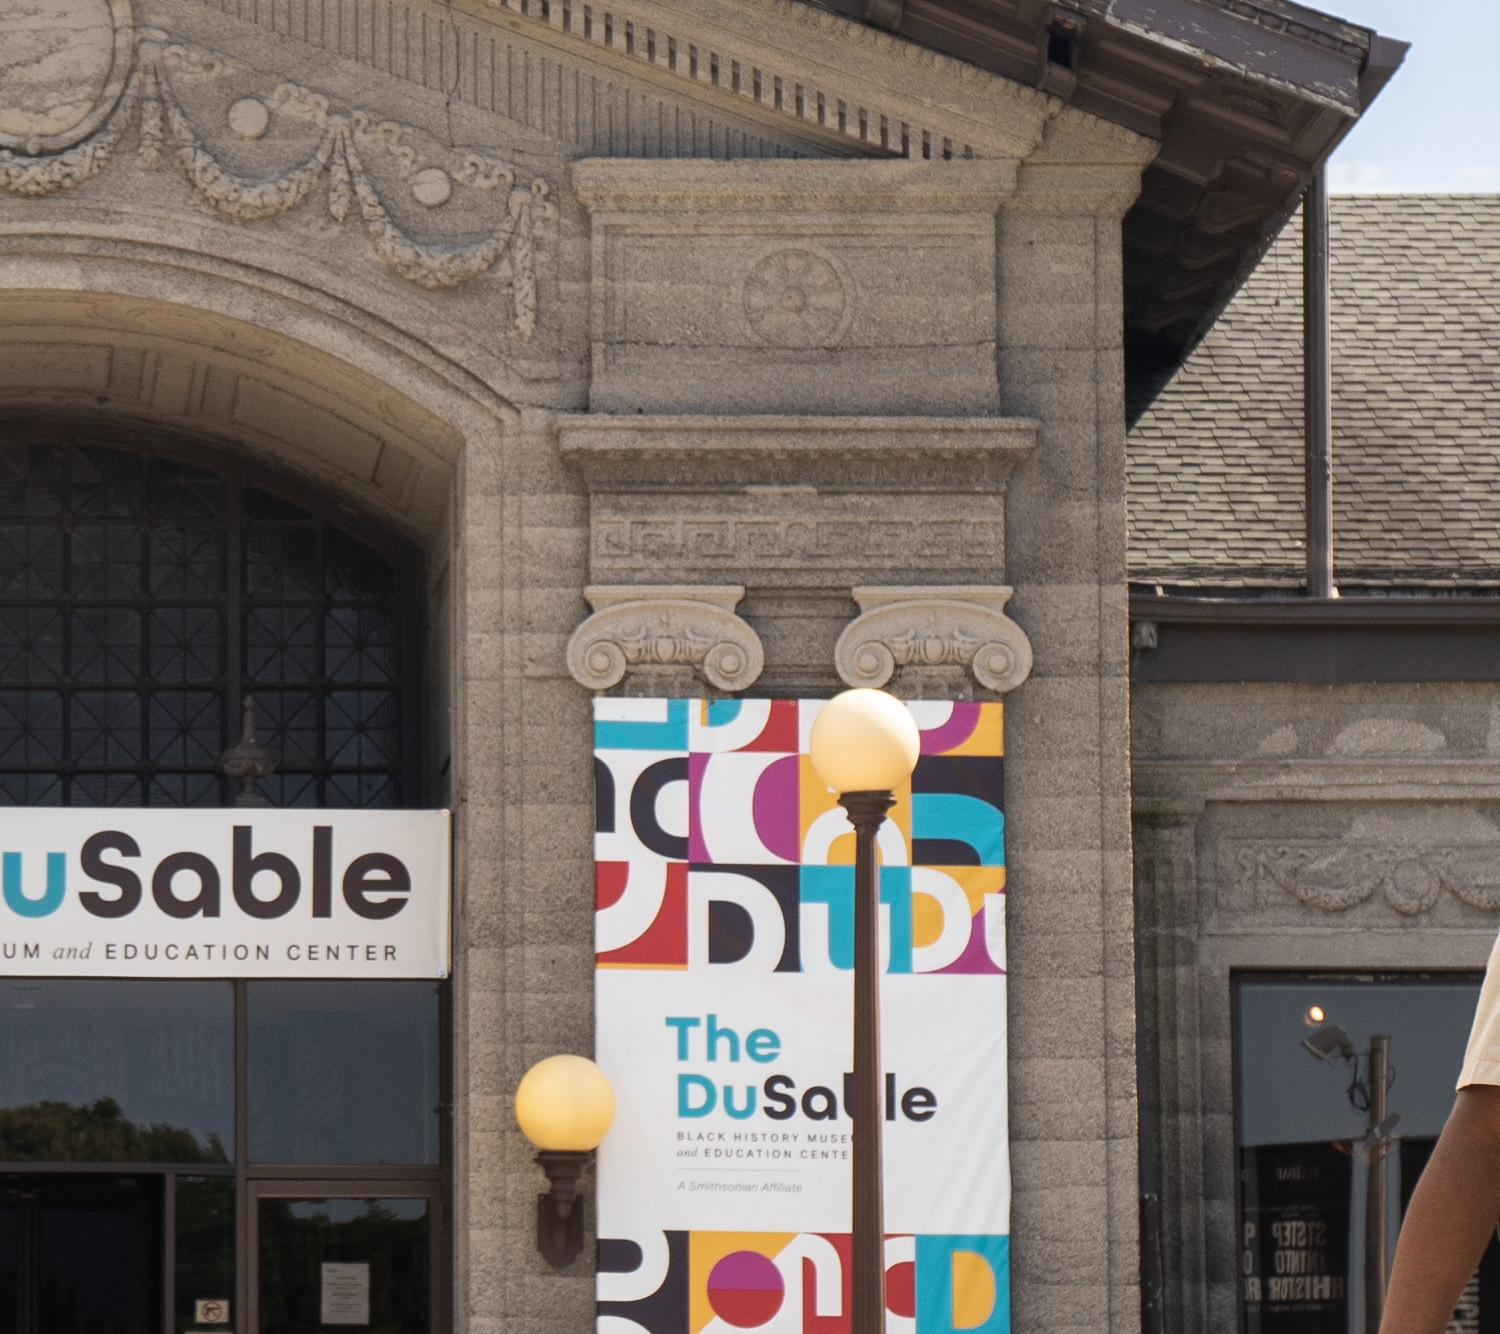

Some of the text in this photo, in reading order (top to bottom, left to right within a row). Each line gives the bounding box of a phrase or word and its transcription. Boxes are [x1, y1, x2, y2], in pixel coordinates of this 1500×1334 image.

[52, 942, 93, 960] and
[104, 943, 271, 961] EDUCATION
[286, 944, 398, 962] CENTER
[665, 1013, 782, 1064] The
[677, 1131, 853, 1144] BLACK HISTORY MUSE
[677, 1147, 849, 1160] and EDUCATION CENTE
[677, 1180, 803, 1194] A Smithsonian Affiliate
